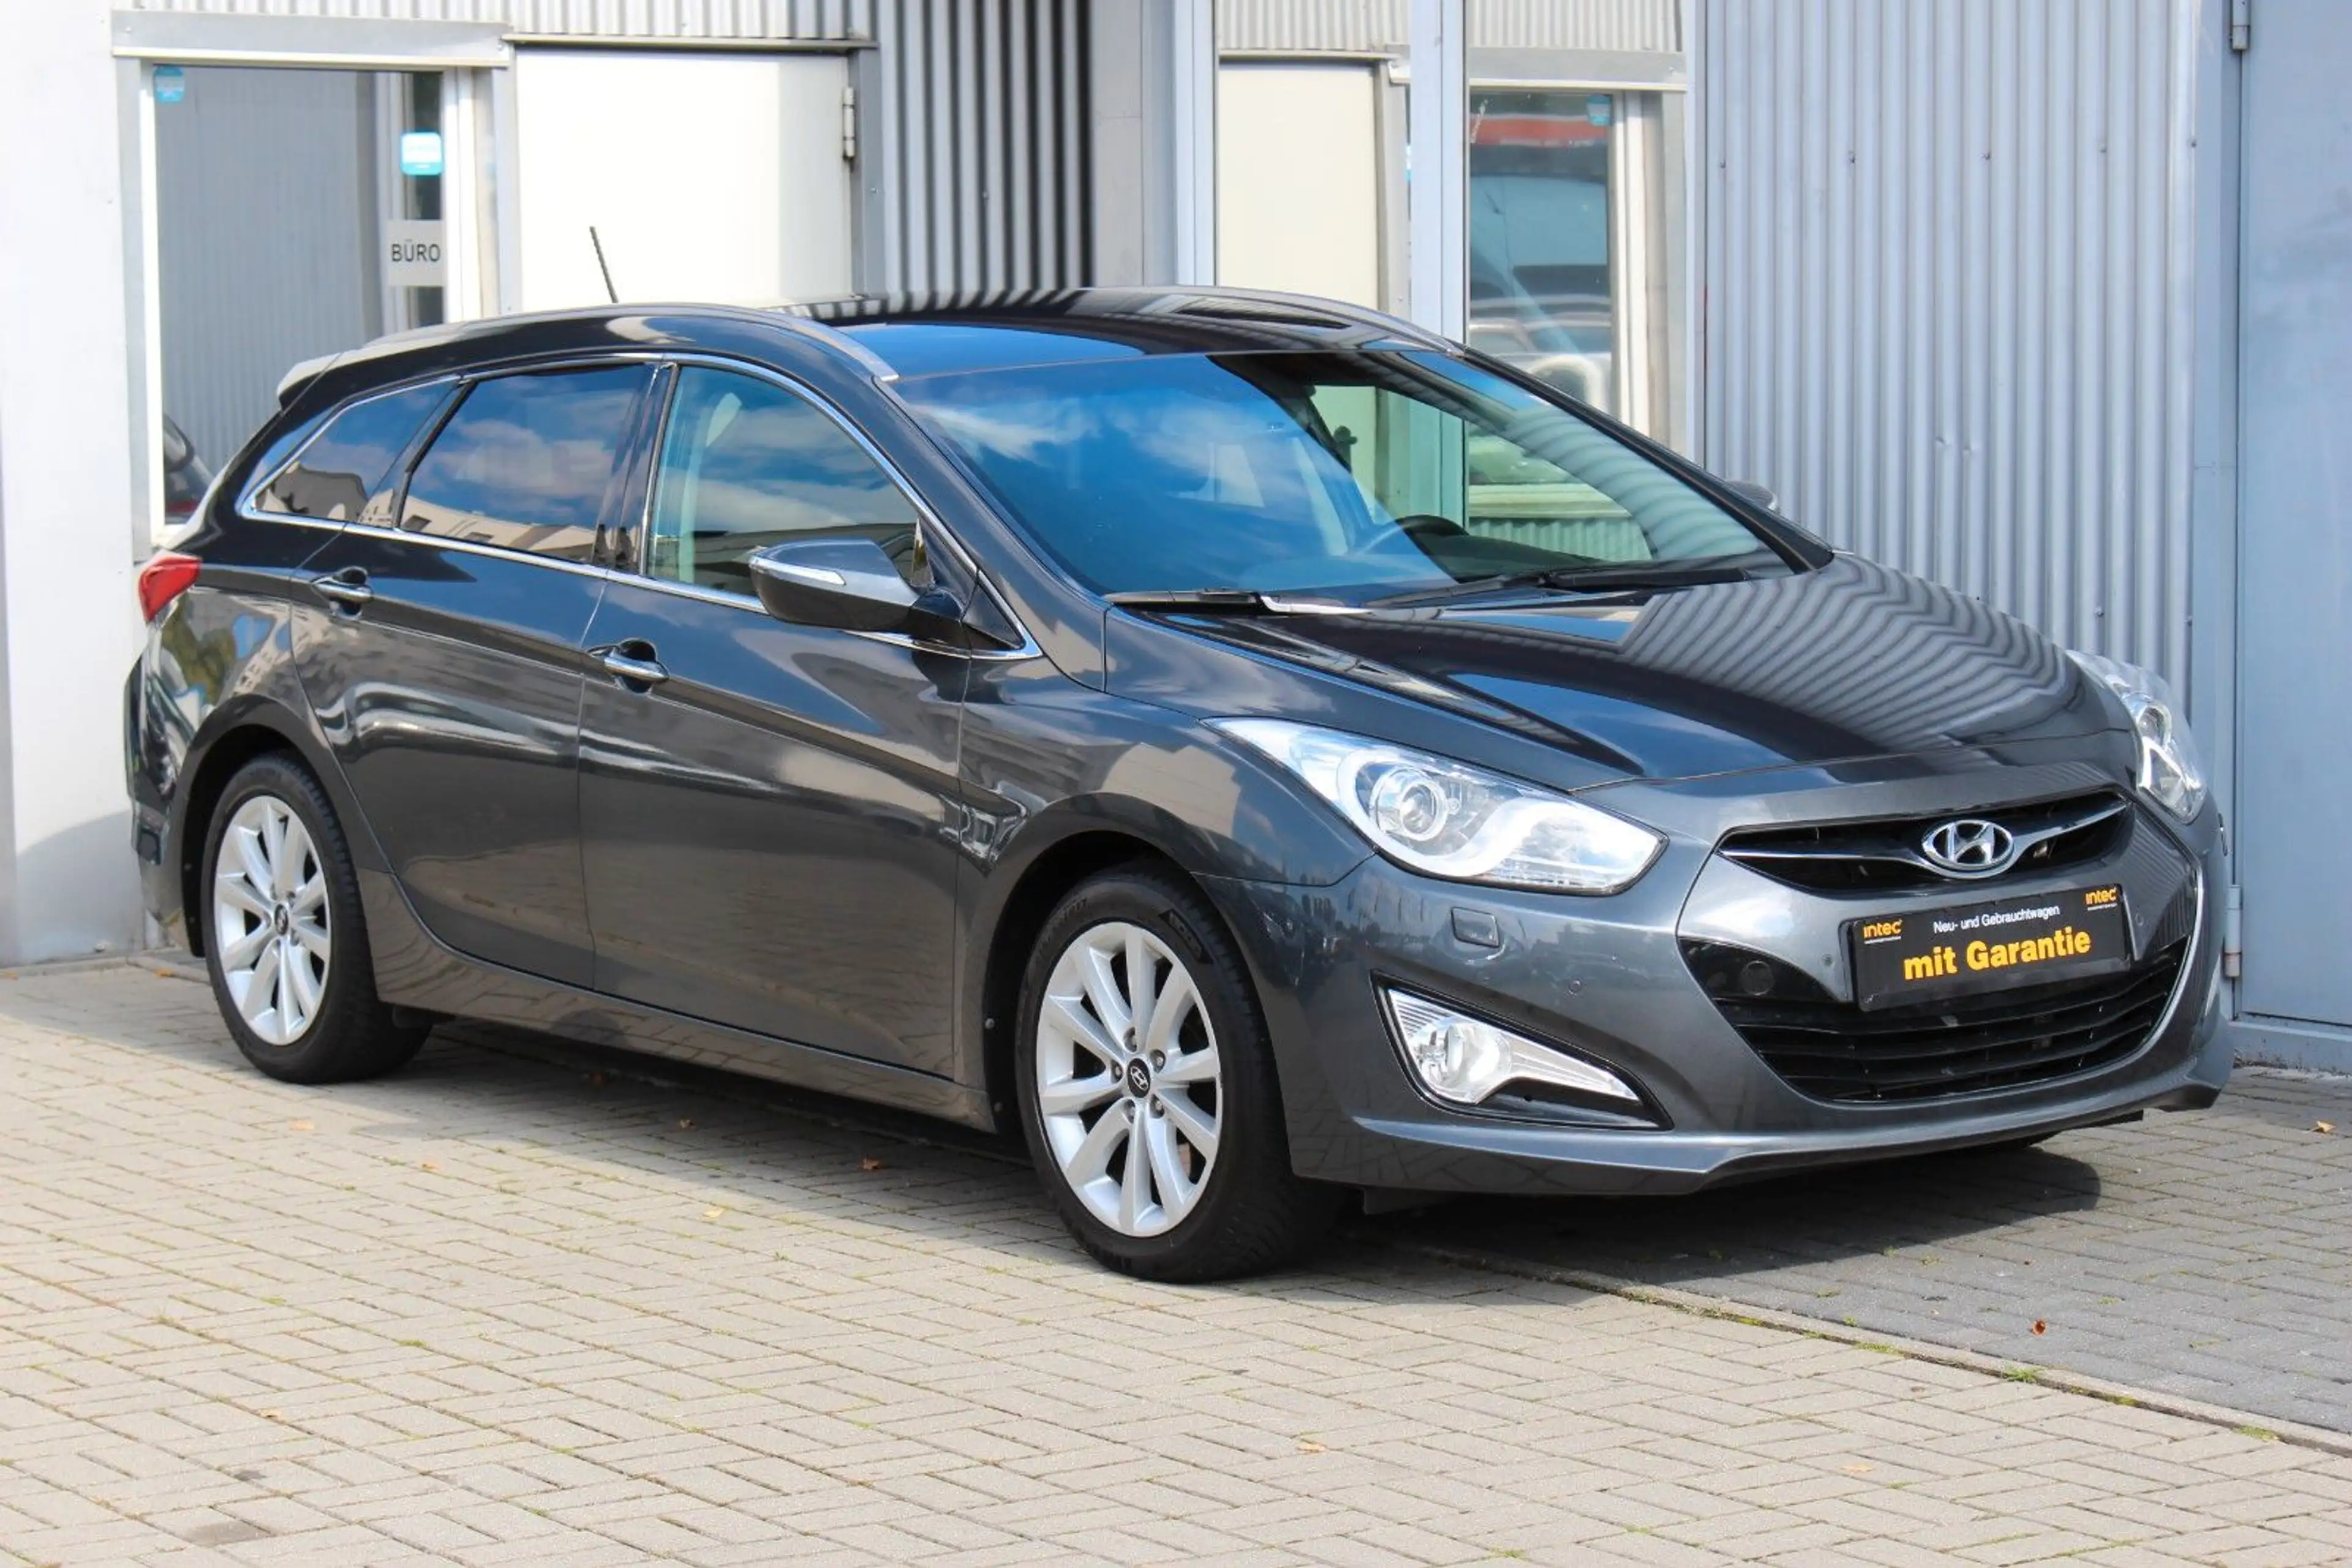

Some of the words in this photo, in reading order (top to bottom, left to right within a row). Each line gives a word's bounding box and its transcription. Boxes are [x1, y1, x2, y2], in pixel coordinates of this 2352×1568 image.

[391, 238, 441, 262] BÜRO
[1933, 920, 1959, 934] Neu-
[1961, 916, 1980, 930] und
[1981, 904, 2060, 927] Gebrauchtwagen
[1904, 946, 1958, 981] mit
[1966, 925, 2092, 971] Garantie
